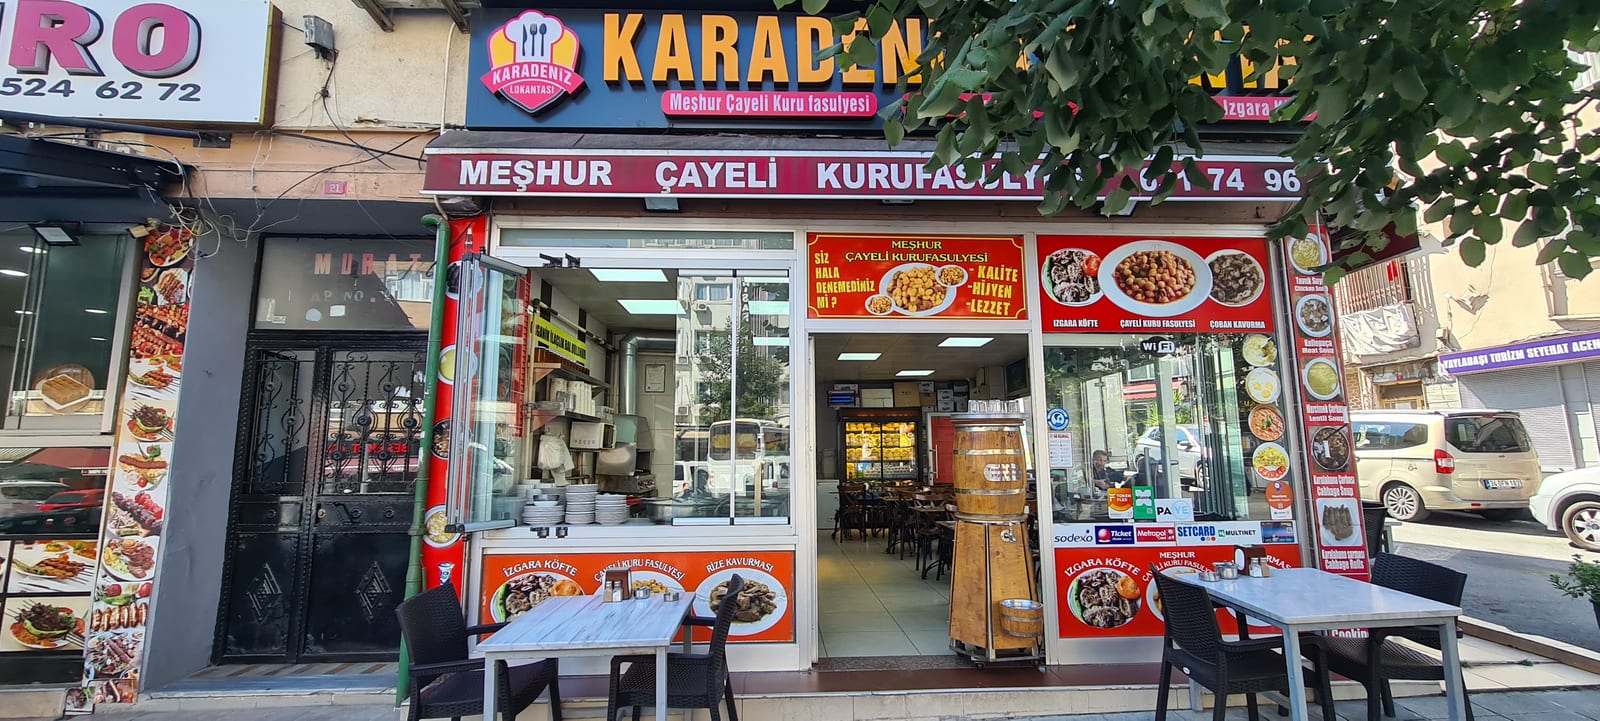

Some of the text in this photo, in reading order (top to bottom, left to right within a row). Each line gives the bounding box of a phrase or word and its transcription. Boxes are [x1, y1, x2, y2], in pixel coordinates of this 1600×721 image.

[493, 64, 573, 86] KARADENİZ
[0, 78, 201, 101] 524 62 72
[509, 85, 555, 95] LOKANTASI
[669, 93, 871, 114] Meşhur Çayeli Kuru fasulyesi
[1223, 99, 1270, 118] Izgara
[459, 159, 612, 191] MEŞHUR
[655, 156, 777, 193] ÇAYELİ
[1207, 168, 1244, 191] 74
[1263, 169, 1301, 192] 96
[891, 240, 942, 251] MEŞHUR
[814, 250, 830, 265] SİZ
[845, 251, 989, 263] ÇAYELİ KURUFASULYESİ
[815, 267, 840, 279] HALA
[978, 264, 1018, 282] KALİTE
[816, 278, 876, 294] DENEMEDİNİZ
[817, 295, 829, 309] Mİ
[1143, 319, 1161, 328] KURU
[1490, 349, 1525, 363] TURİZM
[1527, 342, 1569, 358] SEYEHAT
[1054, 529, 1093, 543] sodexo
[1137, 530, 1166, 538] Metropol
[1177, 525, 1215, 537] SETCARD
[1159, 551, 1196, 559] MEŞHUR
[544, 558, 578, 576] KÖFTE
[622, 558, 644, 568] KURU
[644, 559, 686, 581] FASULYESİ
[706, 557, 774, 573] RİZE KAVURMASI
[1105, 557, 1141, 576] KÖFTE
